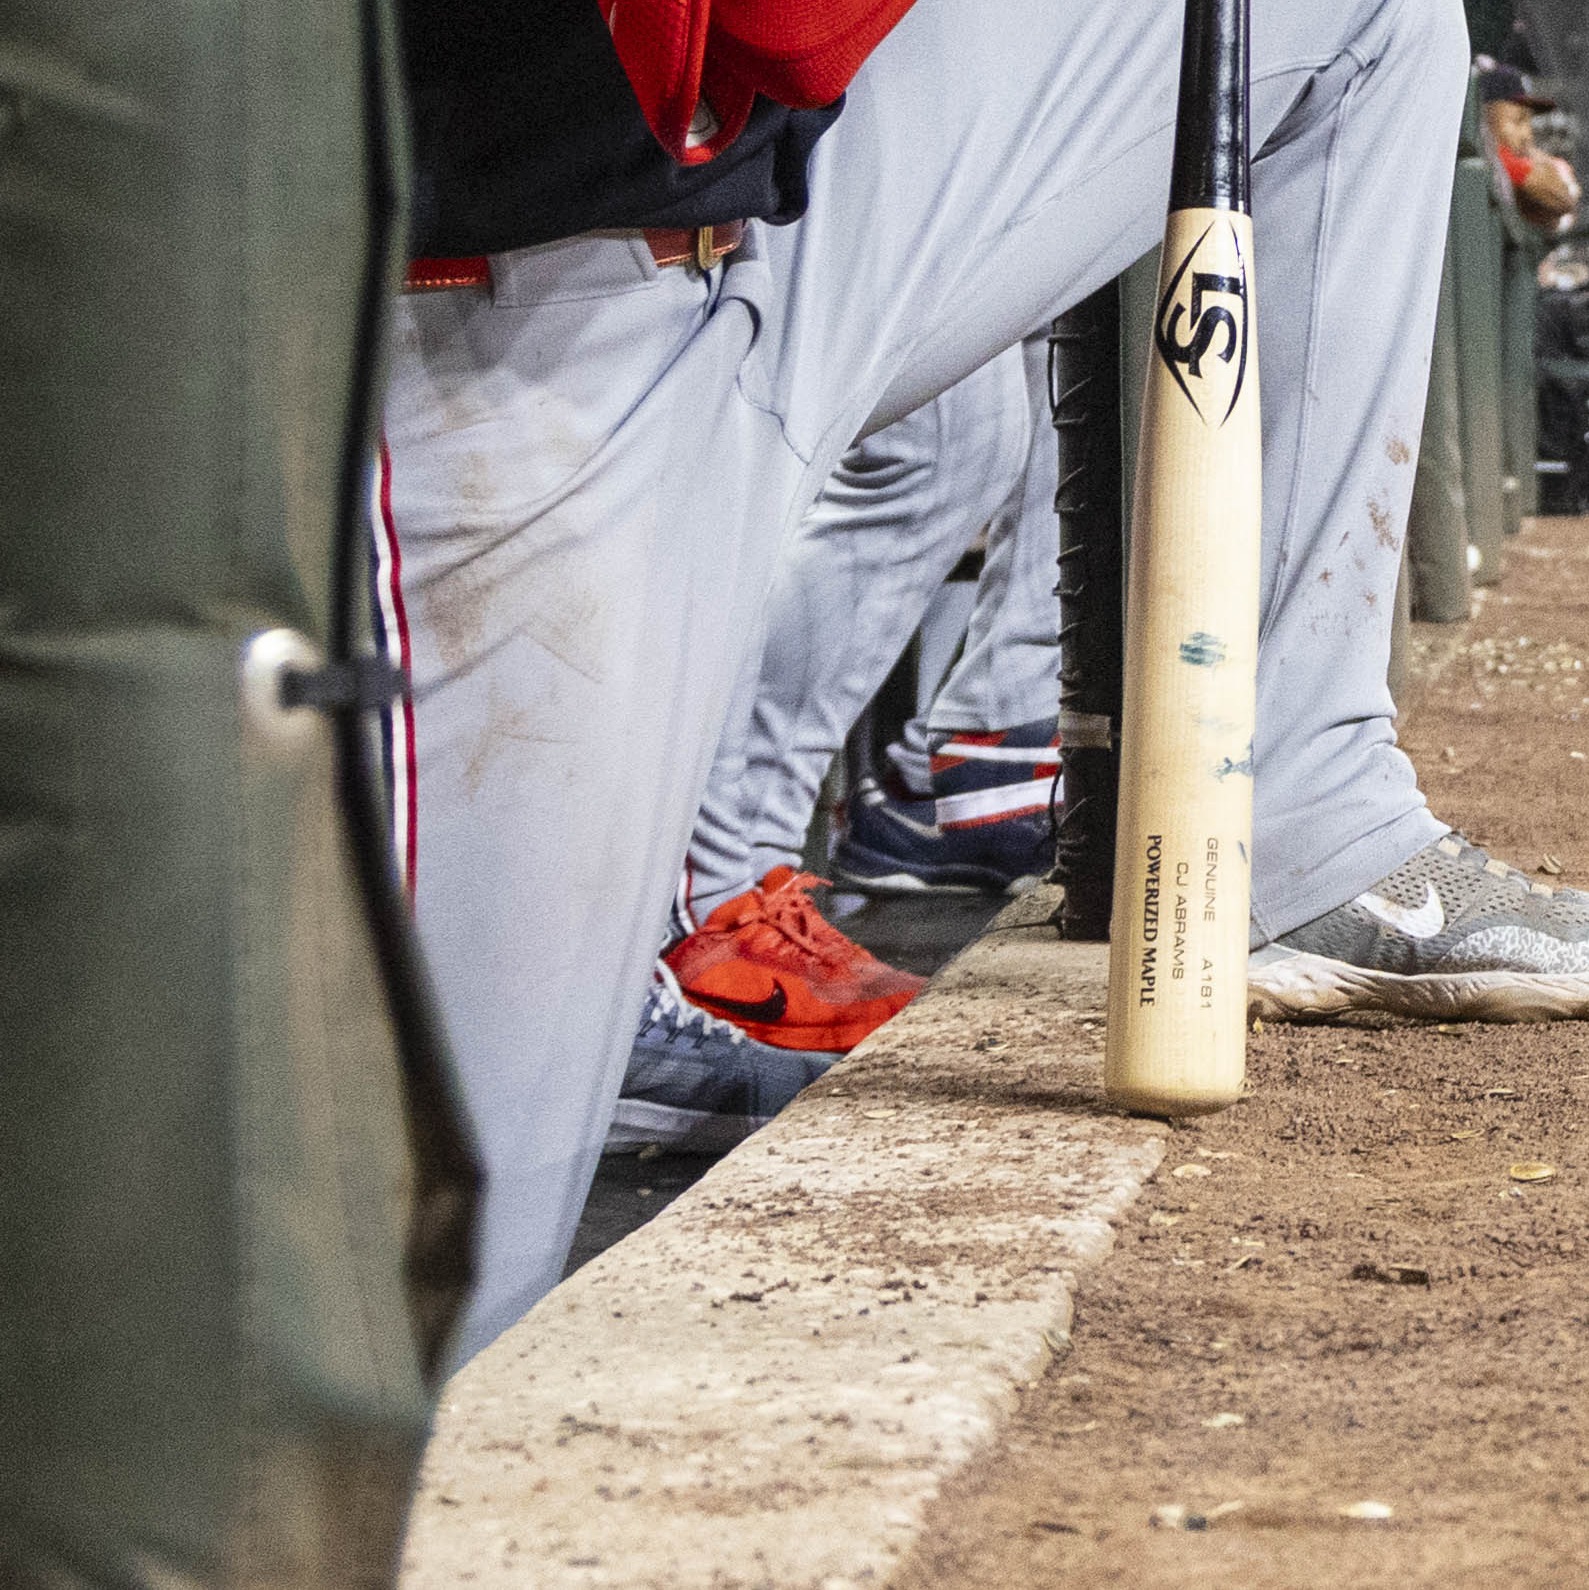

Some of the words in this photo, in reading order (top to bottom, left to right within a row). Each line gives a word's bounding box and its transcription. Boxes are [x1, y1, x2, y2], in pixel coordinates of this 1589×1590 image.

[1143, 834, 1163, 943] POWERIZED
[1176, 861, 1189, 888] CJ
[1203, 836, 1219, 923] GENUINE
[1171, 894, 1187, 981] ABRAMS
[1140, 946, 1157, 1008] MAPLE
[1199, 957, 1214, 1010] A181
